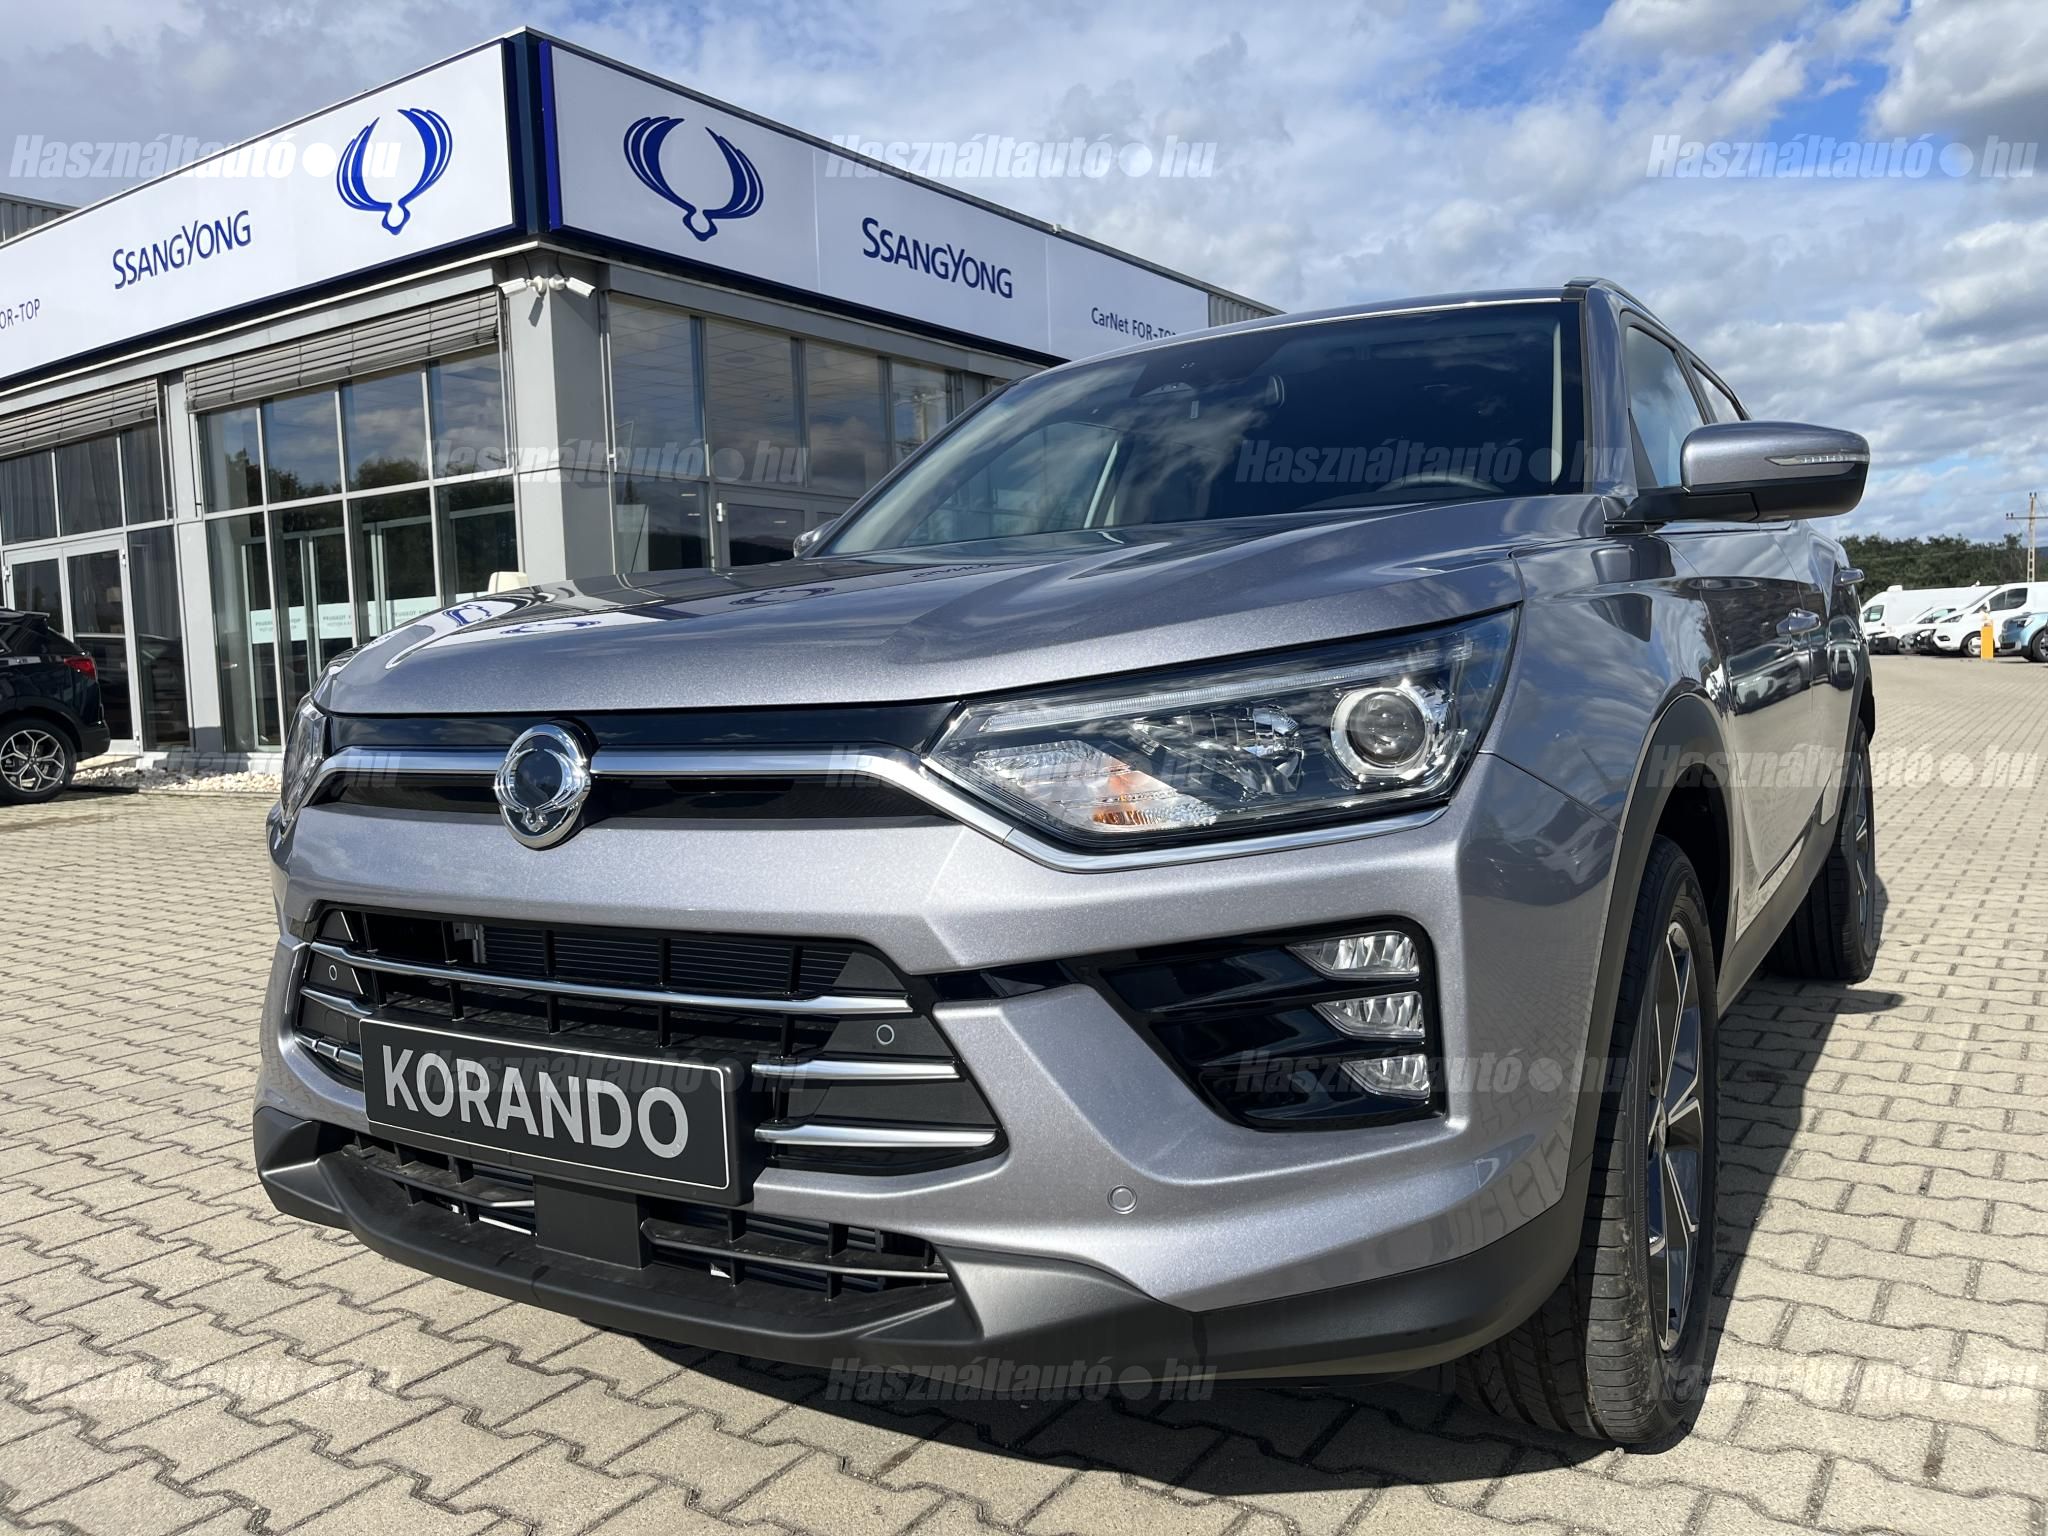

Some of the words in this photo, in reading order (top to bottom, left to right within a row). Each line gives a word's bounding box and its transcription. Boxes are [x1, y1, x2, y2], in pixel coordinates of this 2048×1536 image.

[1091, 307, 1129, 334] CarNet
[1132, 319, 1177, 341] FOR-T
[382, 1045, 690, 1159] KORANDO
